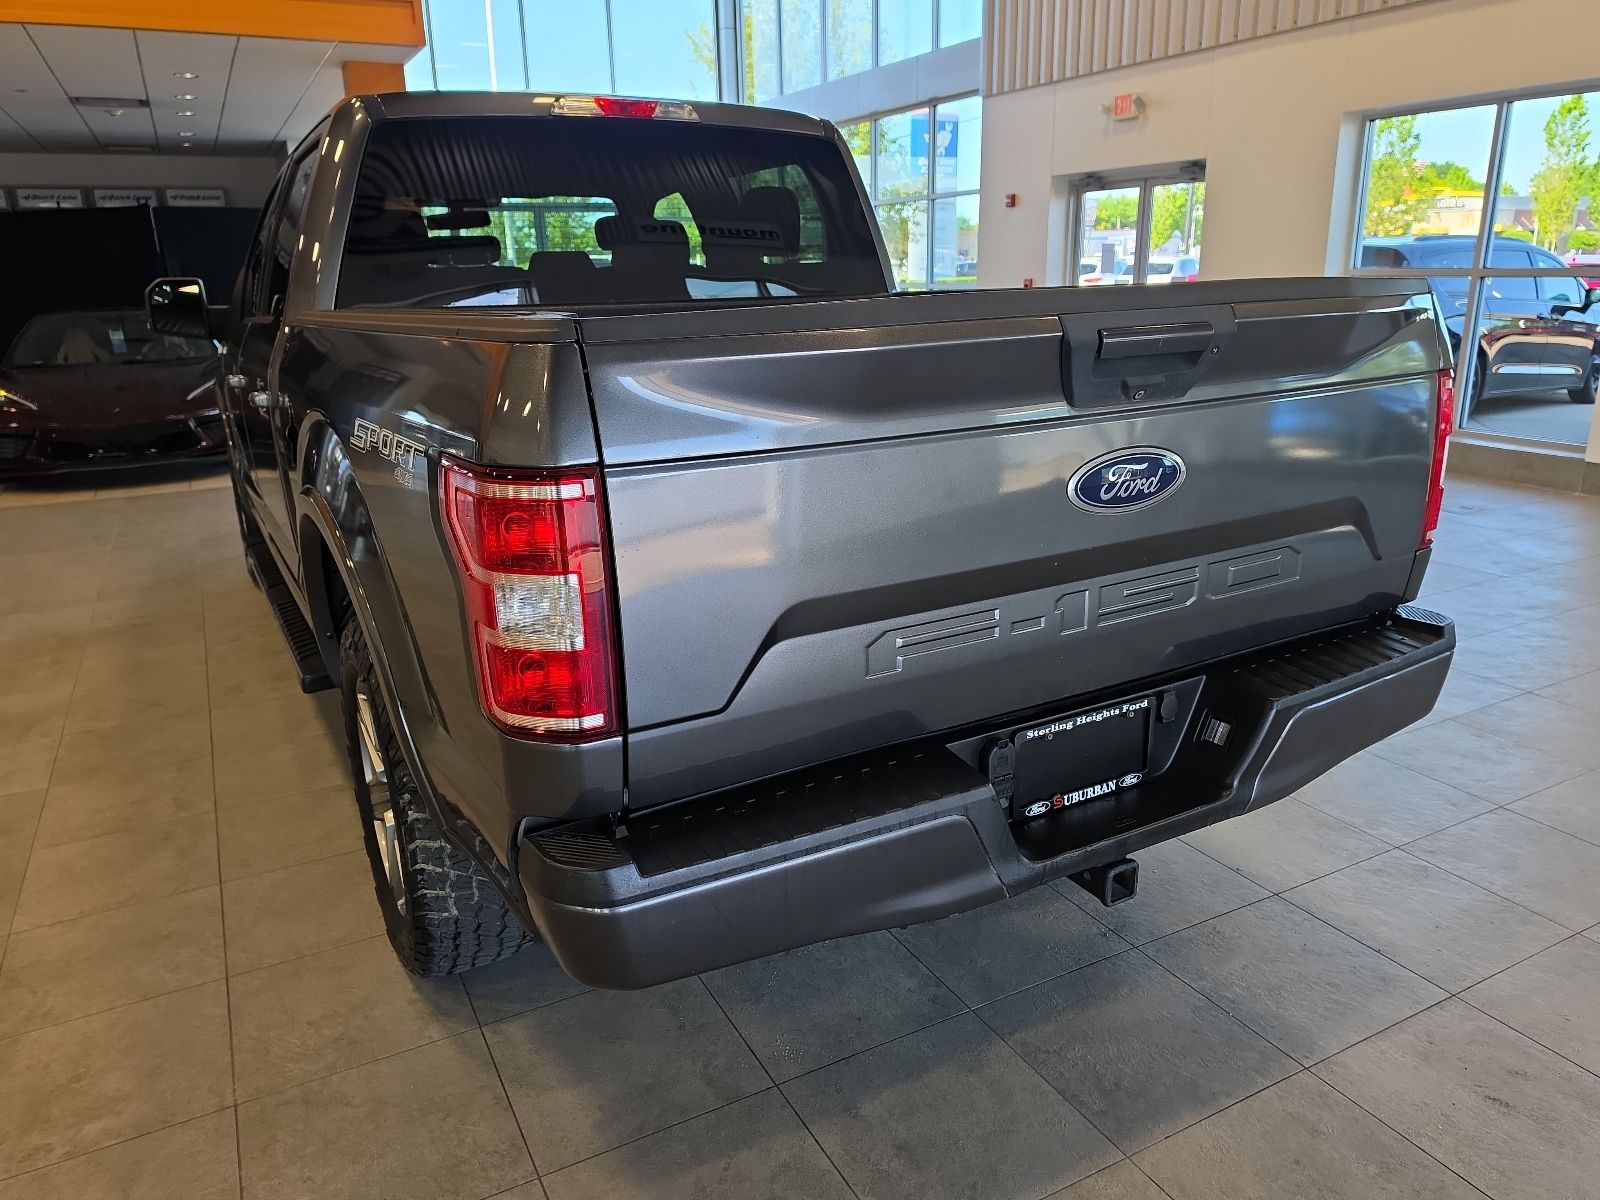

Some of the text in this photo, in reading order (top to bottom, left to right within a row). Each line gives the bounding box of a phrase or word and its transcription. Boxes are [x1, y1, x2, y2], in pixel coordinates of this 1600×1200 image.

[1114, 93, 1133, 116] EXIT
[350, 418, 425, 471] SPORT
[1100, 462, 1163, 501] Ford
[865, 545, 1302, 680] F-150
[1026, 700, 1149, 740] Sterling Heights Ford
[1029, 773, 1140, 815] Ford SUBURBAN Ford
